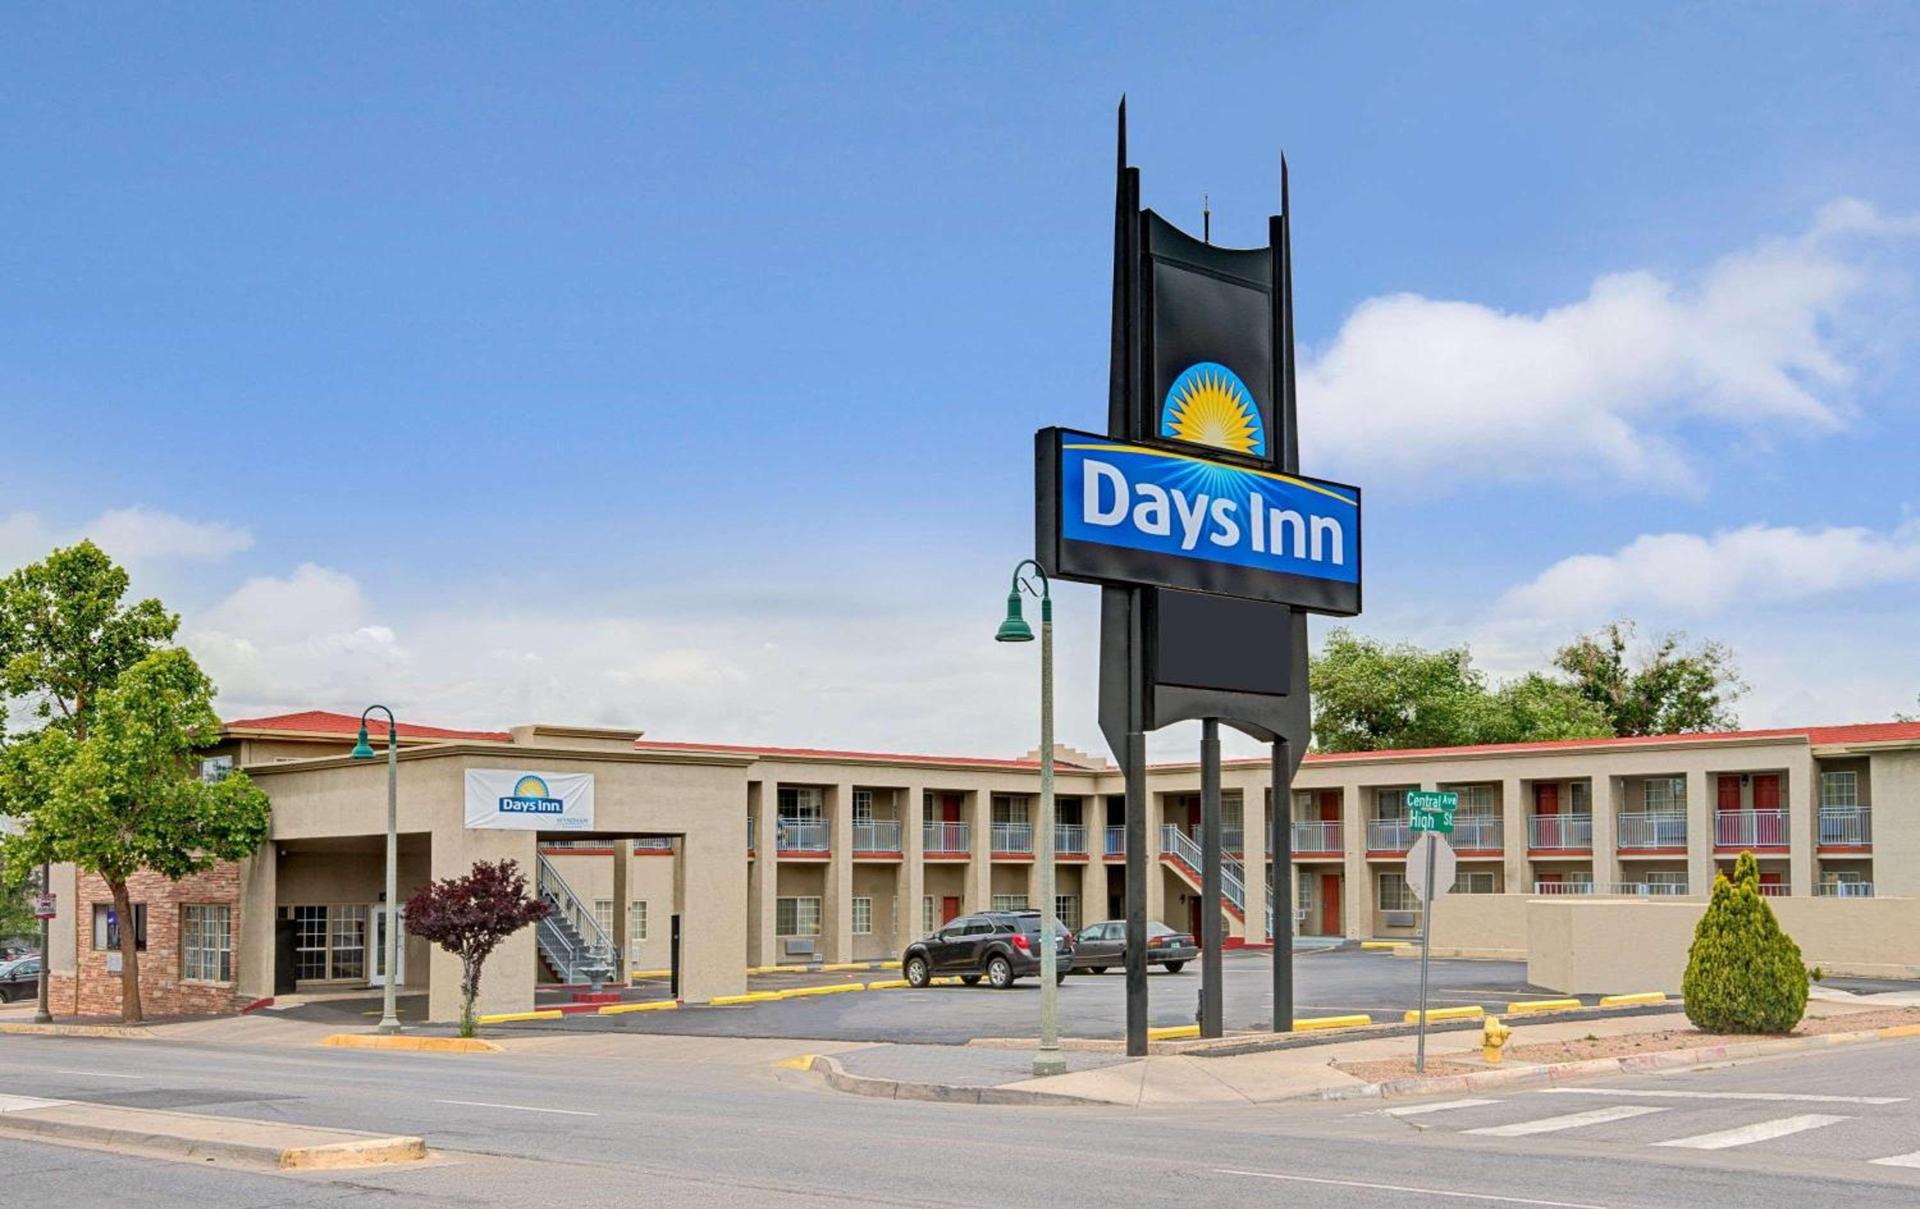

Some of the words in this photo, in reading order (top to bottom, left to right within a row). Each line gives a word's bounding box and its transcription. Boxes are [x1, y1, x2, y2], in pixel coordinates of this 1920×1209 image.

[1083, 458, 1240, 549] Days
[1250, 491, 1343, 565] Inn
[503, 799, 536, 812] Days
[538, 800, 561, 811] Inn
[1407, 792, 1441, 808] Central
[1442, 795, 1457, 805] Ave
[1410, 809, 1434, 831] High
[1443, 811, 1453, 826] St
